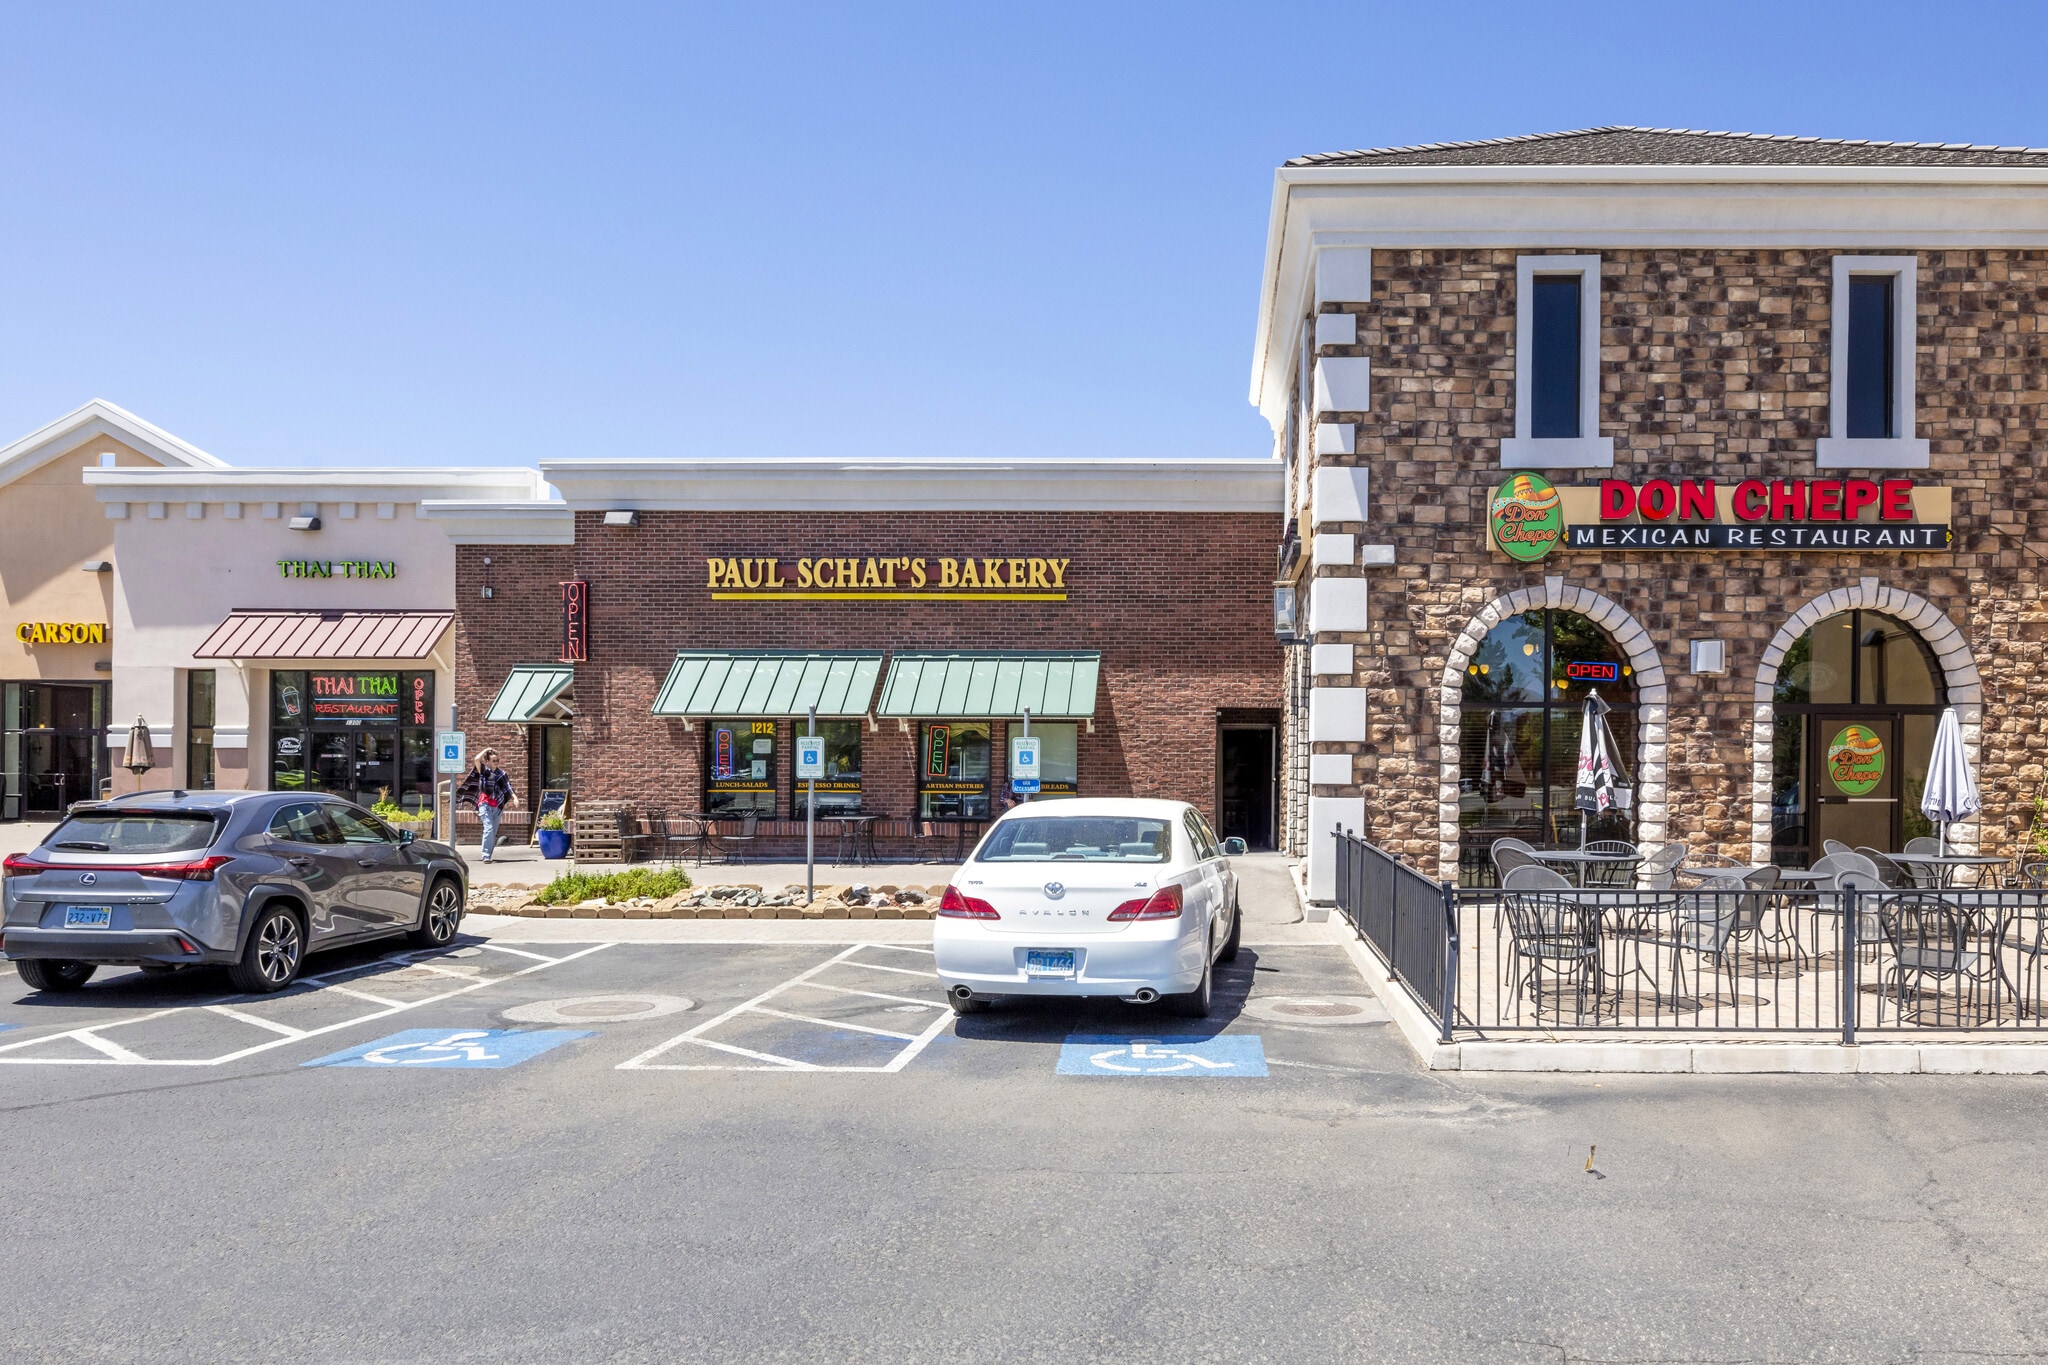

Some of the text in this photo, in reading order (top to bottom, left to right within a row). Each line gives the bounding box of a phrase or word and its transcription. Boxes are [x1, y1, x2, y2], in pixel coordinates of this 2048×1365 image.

[1600, 479, 1914, 521] DON CHEPE
[1504, 501, 1549, 522] Don
[1498, 521, 1558, 546] Chepe
[1576, 527, 1938, 546] MEXICAN RESTAURANT
[277, 560, 396, 579] THAI THAI
[706, 556, 1071, 588] PAUL SCHAT'S BAKERY
[567, 583, 580, 659] OPEN
[15, 622, 106, 644] CARSON
[1567, 664, 1614, 678] OPEN
[312, 676, 398, 695] THAI THAI
[315, 703, 398, 715] RESTAURANT
[413, 677, 425, 724] OPEN
[751, 722, 774, 734] 1212
[718, 731, 730, 776] OPEN
[931, 728, 946, 774] OPEN
[1838, 749, 1874, 765] Don
[1832, 765, 1881, 784] Chepe
[1019, 909, 1090, 917] AVALON
